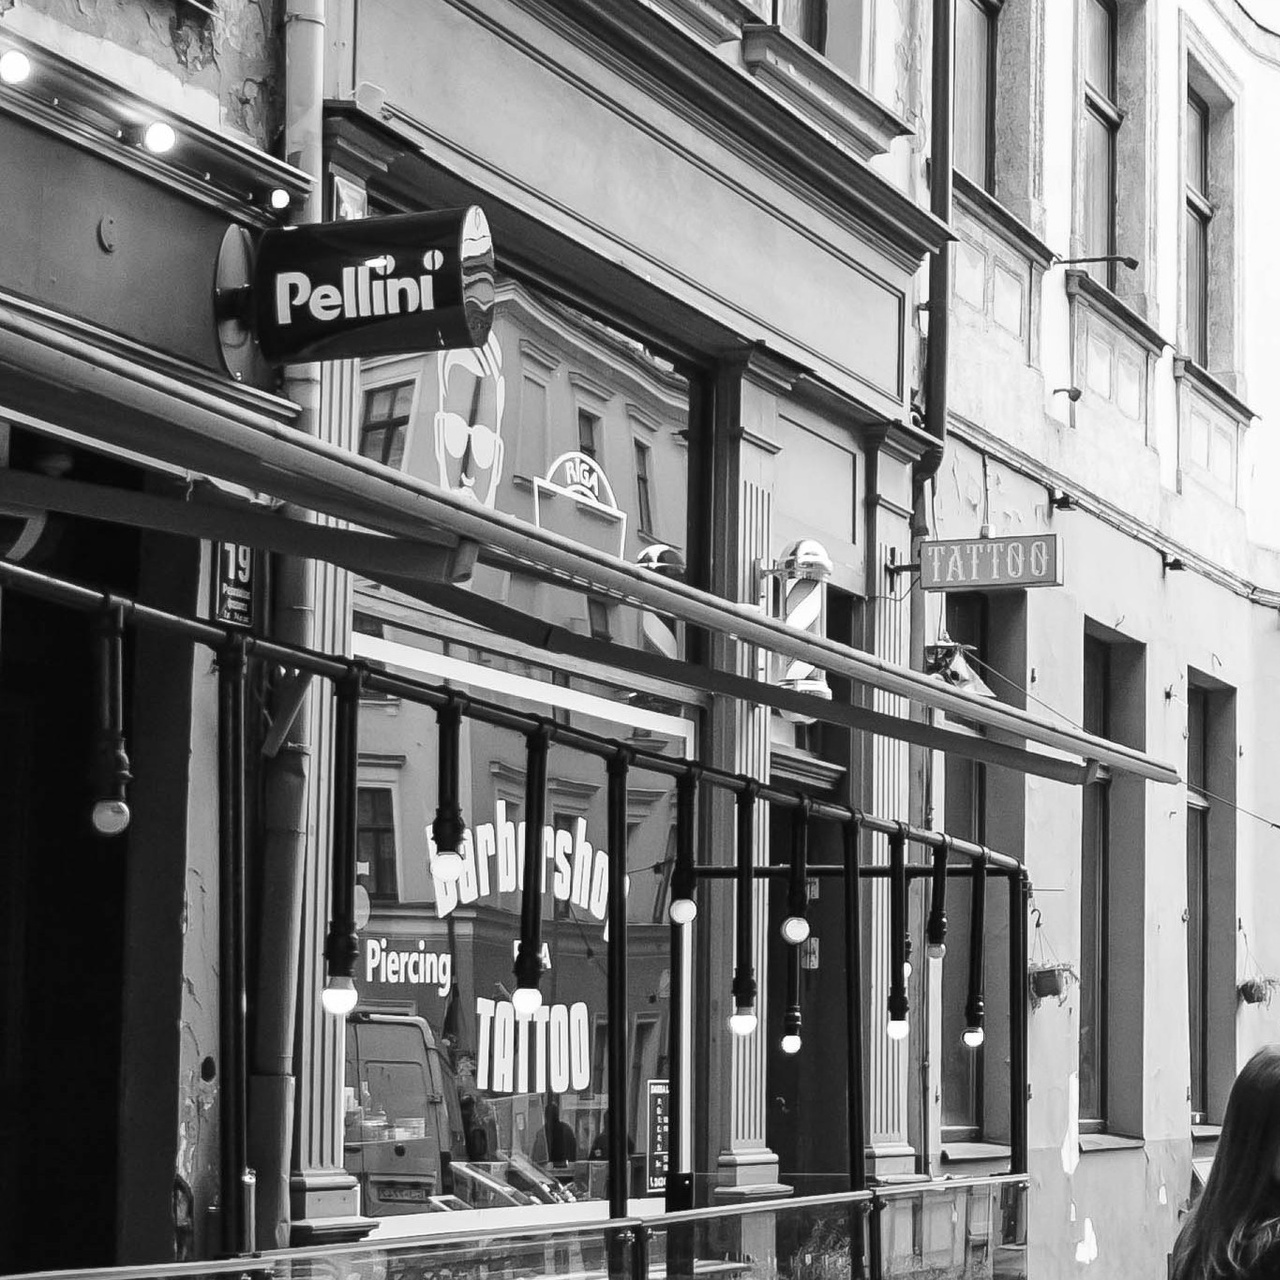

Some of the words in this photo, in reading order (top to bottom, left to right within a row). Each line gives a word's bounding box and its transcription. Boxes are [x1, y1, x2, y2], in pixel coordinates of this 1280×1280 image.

[276, 249, 444, 325] Pellini
[224, 542, 251, 583] 19
[928, 541, 1049, 582] TATTOO
[366, 937, 452, 997] Piercing
[476, 996, 591, 1094] TATTOO
